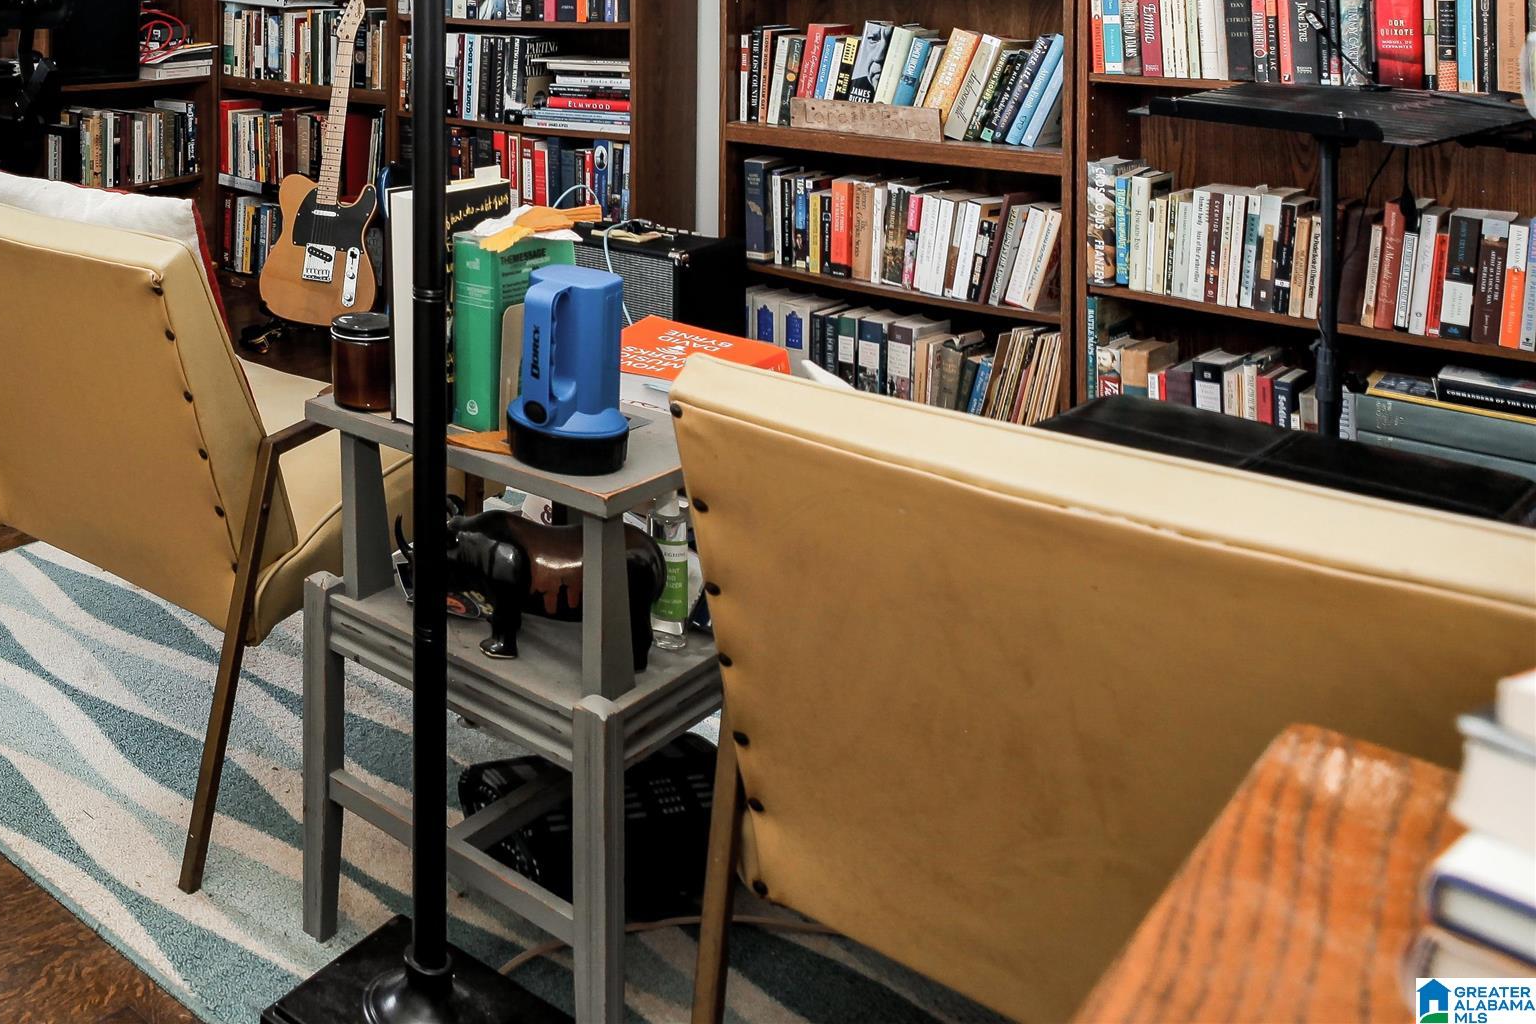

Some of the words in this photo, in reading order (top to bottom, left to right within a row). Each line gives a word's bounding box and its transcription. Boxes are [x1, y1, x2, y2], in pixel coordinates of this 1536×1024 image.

[1121, 6, 1135, 34] RICHARD
[1295, 2, 1308, 21] JANE
[1143, 3, 1156, 44] Emma
[1253, 12, 1265, 48] FAHRENHEIT
[1298, 22, 1308, 43] EYRE
[1381, 28, 1414, 37] QUIXOTE
[1389, 19, 1405, 27] DON
[496, 52, 502, 60] AT
[526, 41, 558, 54] PARTING
[752, 39, 760, 54] THE
[823, 45, 831, 63] LOCAL
[1029, 40, 1045, 66] HARPER
[1124, 35, 1137, 58] ADAMS
[1269, 46, 1276, 55] DU
[752, 55, 760, 73] LOST
[1015, 62, 1022, 70] TO
[1021, 67, 1033, 80] LEE
[836, 72, 845, 93] REX
[945, 63, 958, 86] SONGS
[1008, 71, 1018, 86] KILL
[1033, 68, 1048, 90] Atticus
[465, 84, 473, 114] PROUD
[751, 74, 760, 108] COUNTRY
[850, 86, 872, 98] JAMES
[954, 71, 982, 124] Andersonville
[983, 79, 996, 100] HOURS
[567, 100, 611, 110] ELMWOOD
[990, 92, 1010, 126] Mockingbird
[796, 178, 805, 195] TAPS
[854, 212, 862, 238] Complete
[1212, 200, 1221, 233] EVENTIDE
[1003, 232, 1013, 245] LOST
[998, 254, 1008, 267] THE
[1094, 239, 1105, 284] FRANZEN
[1527, 281, 1536, 311] PAINTED
[658, 335, 721, 352] DAVID
[665, 329, 734, 347] BYRNE
[530, 323, 541, 380] DORCY
[1446, 389, 1494, 404] COMMANDERS
[1506, 399, 1521, 409] THE
[1277, 394, 1288, 428] Soldier
